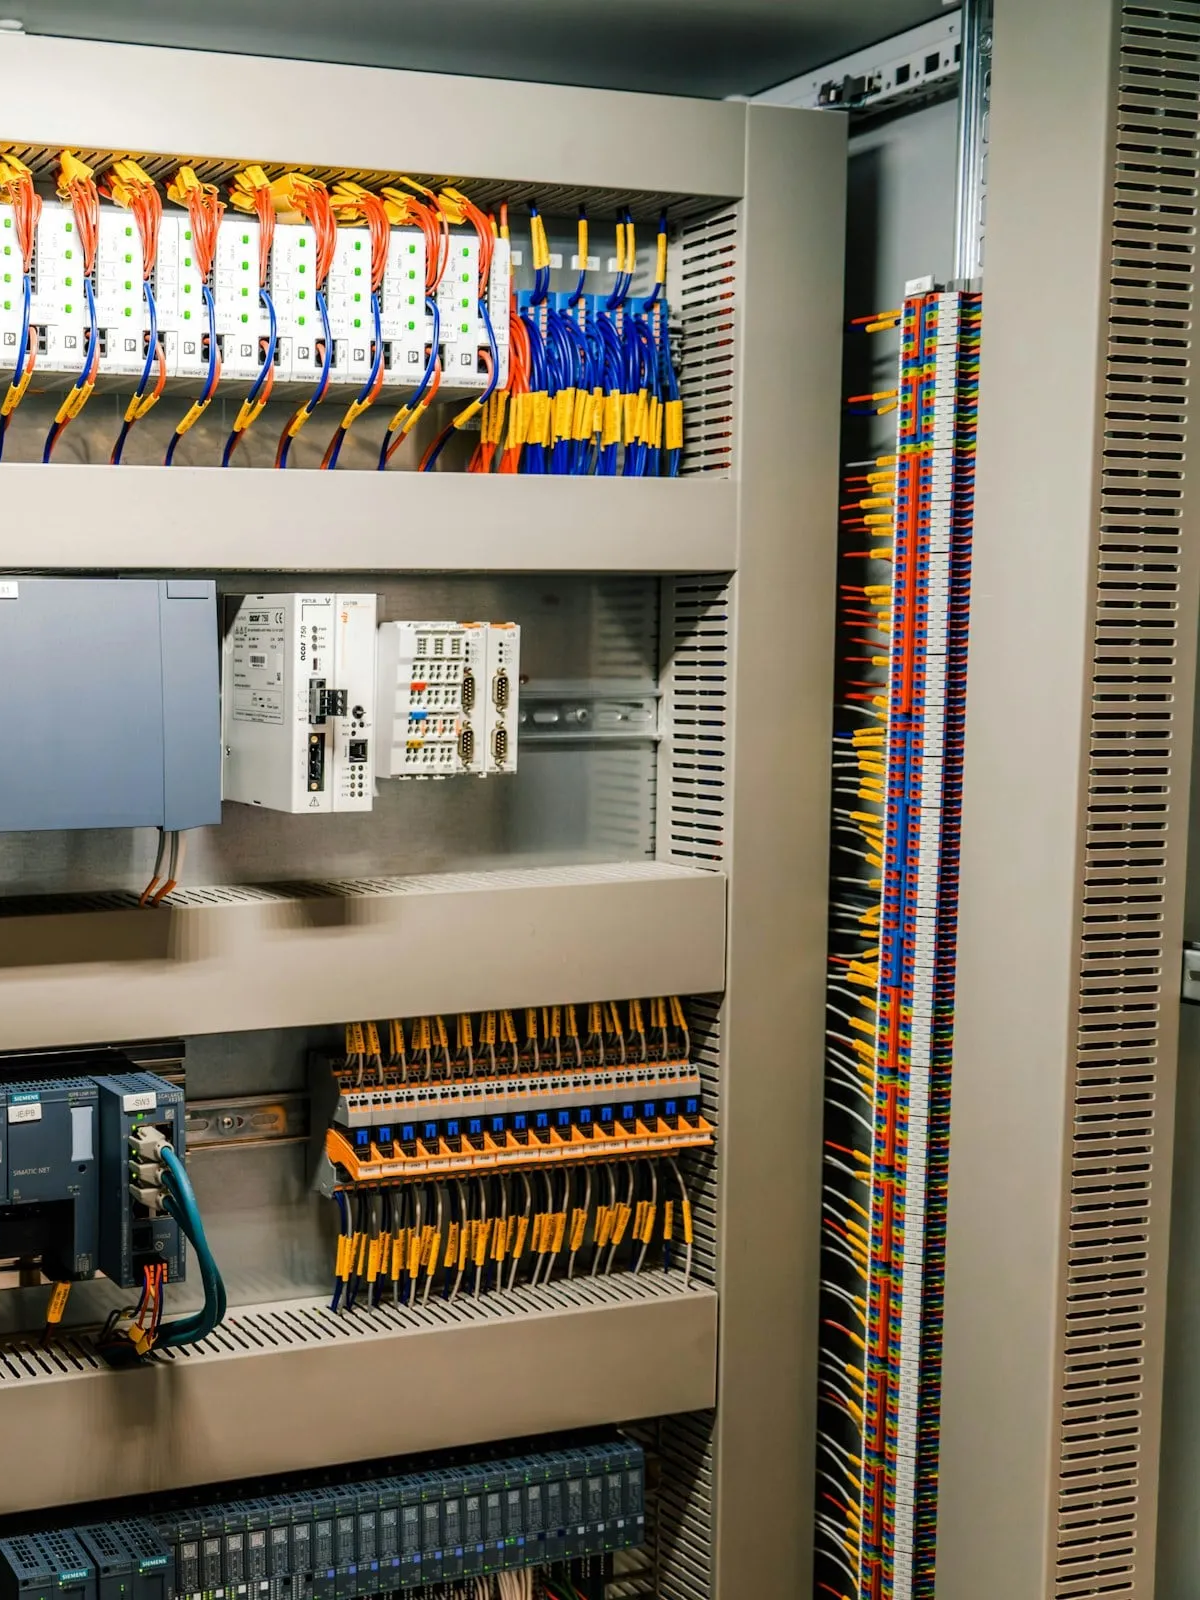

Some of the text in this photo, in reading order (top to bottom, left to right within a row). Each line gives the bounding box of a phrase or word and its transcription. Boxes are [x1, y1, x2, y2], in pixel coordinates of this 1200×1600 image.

[13, 1094, 39, 1102] SIEMENS
[133, 1097, 150, 1107] -SW3
[12, 1166, 51, 1176] SIMATIC NET
[141, 1558, 167, 1567] SIEMENS
[61, 1571, 87, 1580] SIEMENS
